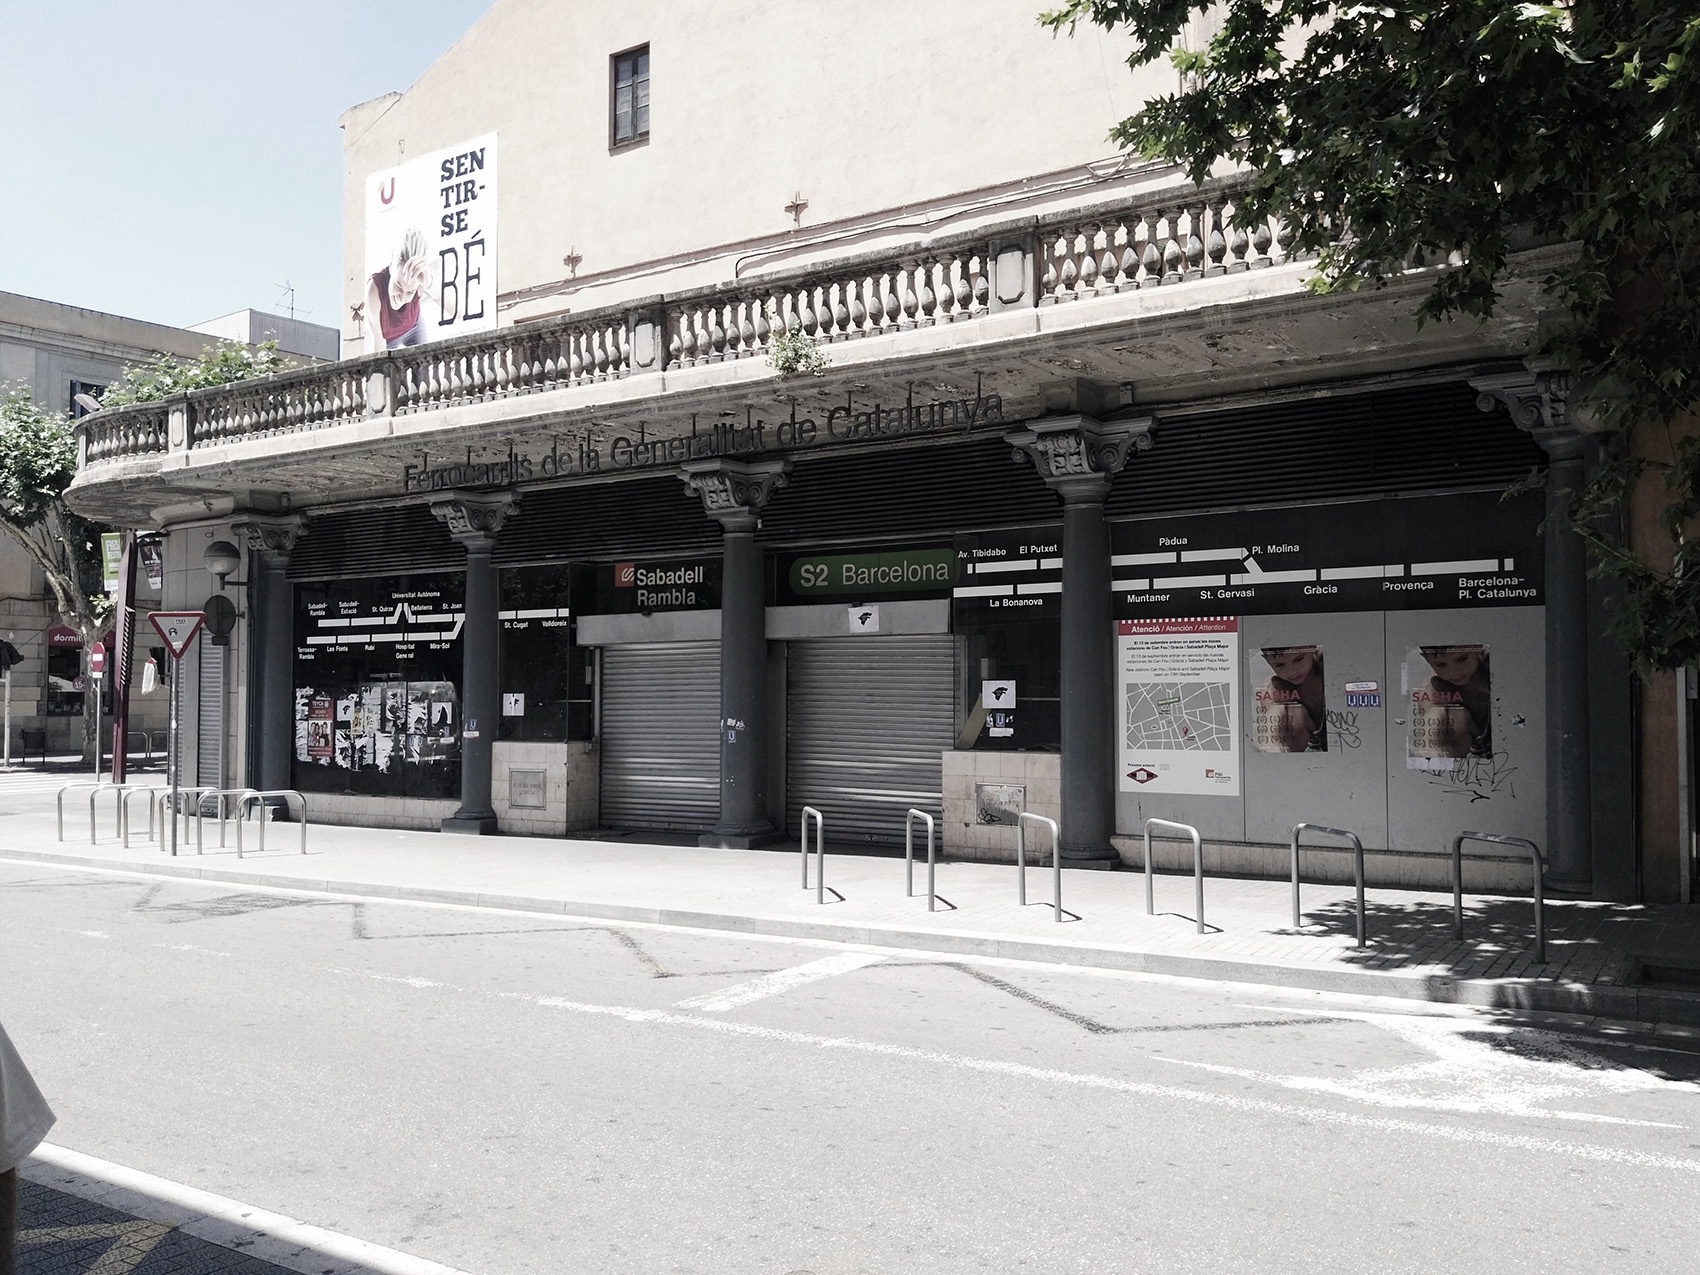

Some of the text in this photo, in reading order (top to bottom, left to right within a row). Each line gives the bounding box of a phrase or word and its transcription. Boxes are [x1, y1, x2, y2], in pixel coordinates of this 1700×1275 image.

[441, 147, 486, 182] SEN
[441, 179, 486, 209] TIR-
[441, 209, 468, 237] SE
[438, 229, 485, 327] BÉ
[403, 393, 1004, 492] Ferrocarrils de la Generalitat de Catalunya
[1159, 536, 1188, 546] Pàdua
[958, 548, 1007, 558] Av. Tibidabo
[1019, 544, 1058, 554] El Putxet
[1252, 543, 1300, 555] Pl. Molina
[636, 566, 704, 586] Sabadell
[800, 561, 949, 587] S2 Barcelona
[1383, 581, 1434, 591] Provença
[1459, 576, 1525, 587] Barcelona-
[1200, 588, 1255, 600] St. Gervasi
[1303, 585, 1338, 595] Gràcia
[1459, 588, 1537, 599] Pl. Catalunya
[637, 588, 696, 606] Rambla
[989, 598, 1043, 607] La Bonanova
[1127, 593, 1171, 603] Muntaner
[504, 620, 529, 629] St. Cugat
[542, 619, 567, 627] Valldoreix
[1255, 689, 1301, 701] SASHA
[1412, 691, 1464, 703] SASHA
